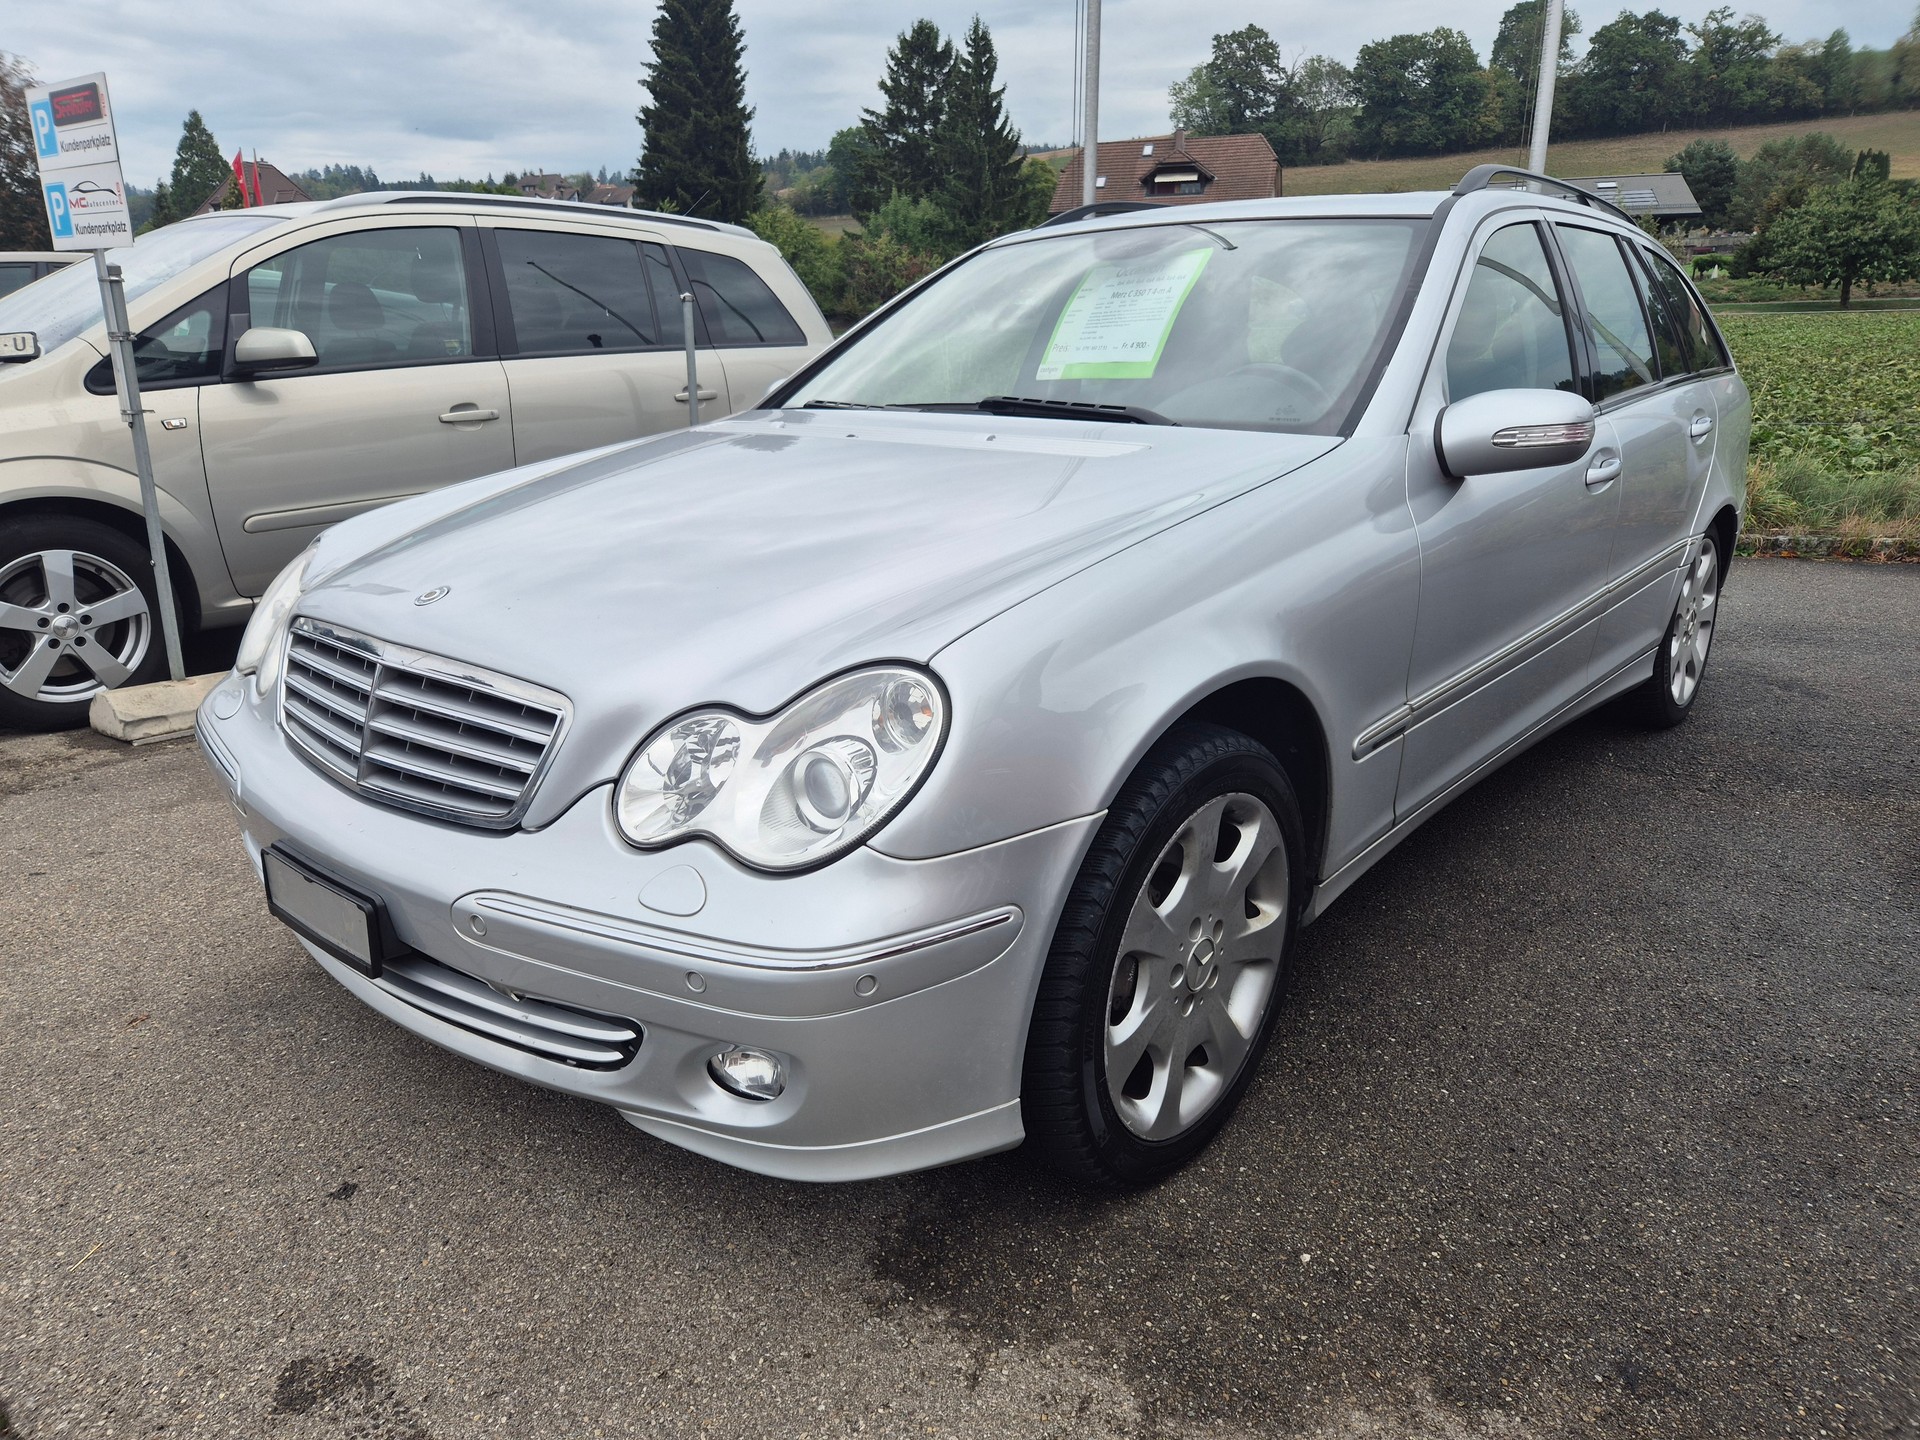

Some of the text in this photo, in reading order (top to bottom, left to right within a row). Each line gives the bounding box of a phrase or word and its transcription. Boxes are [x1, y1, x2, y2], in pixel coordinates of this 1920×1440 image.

[35, 109, 49, 149] P
[60, 134, 112, 153] Kundenparkplatz
[51, 191, 65, 230] P
[75, 221, 127, 236] Kundenparkplatz
[1128, 290, 1134, 298] C
